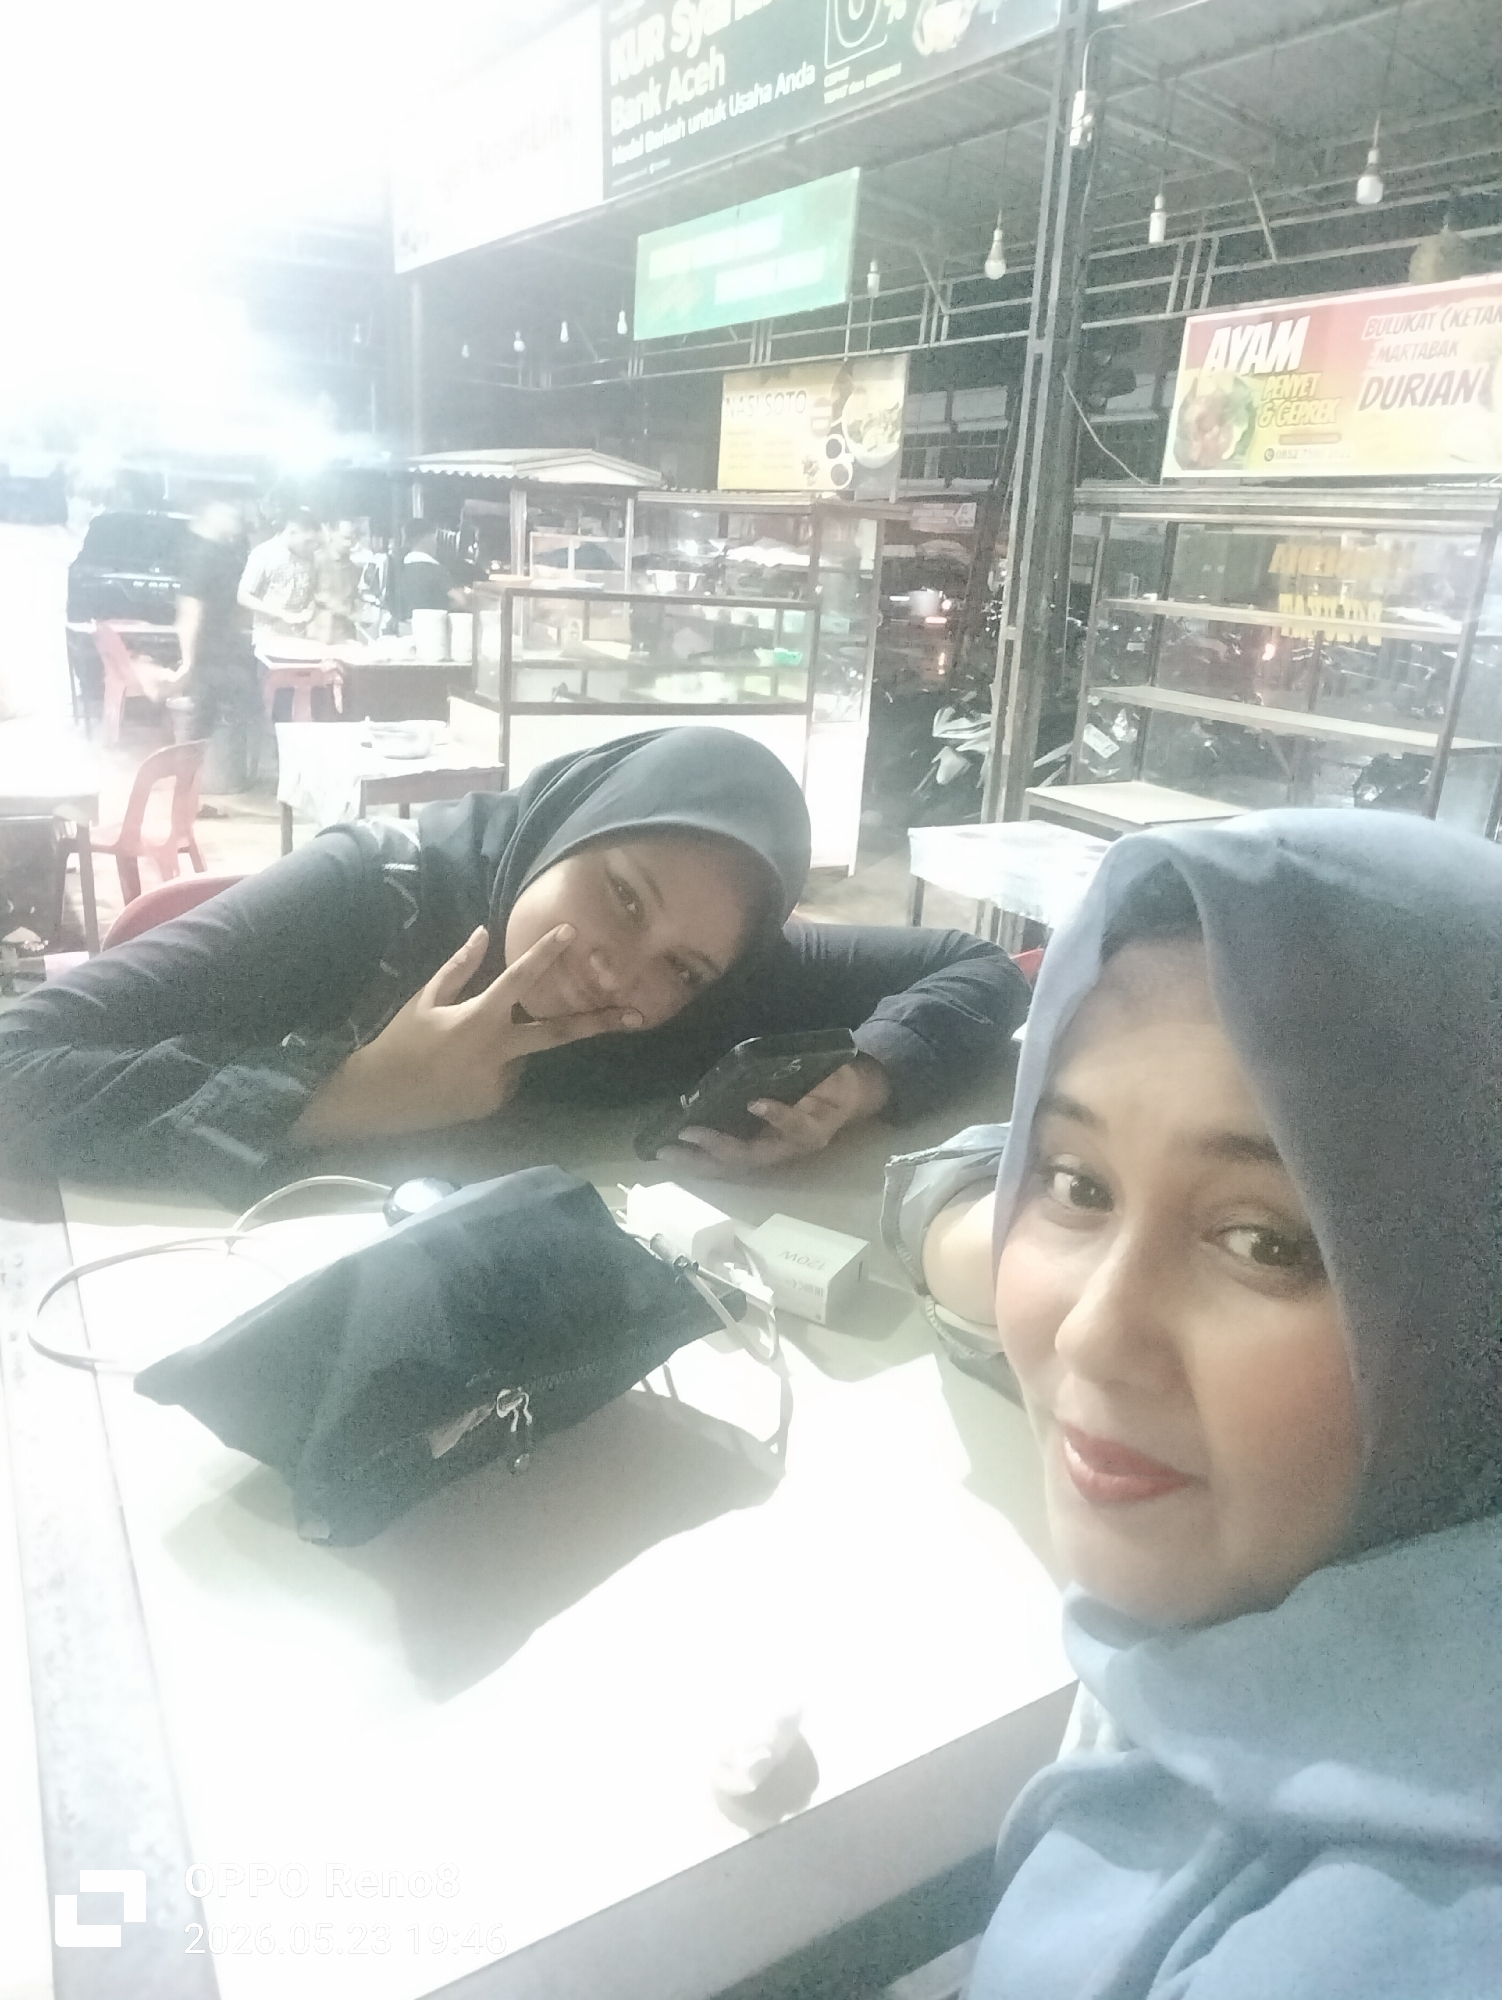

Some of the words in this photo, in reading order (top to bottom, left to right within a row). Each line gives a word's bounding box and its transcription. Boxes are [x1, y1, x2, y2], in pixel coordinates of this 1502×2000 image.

[610, 13, 665, 86] KUR
[611, 76, 661, 136] Bank
[666, 46, 725, 110] Aceh
[688, 99, 727, 135] untuk
[728, 82, 772, 118] Usaha
[774, 59, 816, 99] Anda
[1365, 312, 1437, 337] BULUKAT
[1201, 316, 1311, 377] AYAM
[1375, 339, 1460, 363] MARTABAK
[765, 389, 807, 416] SOTO
[1262, 373, 1321, 401] PENYET
[1358, 367, 1485, 411] DURIAN
[778, 1250, 826, 1271] 120W
